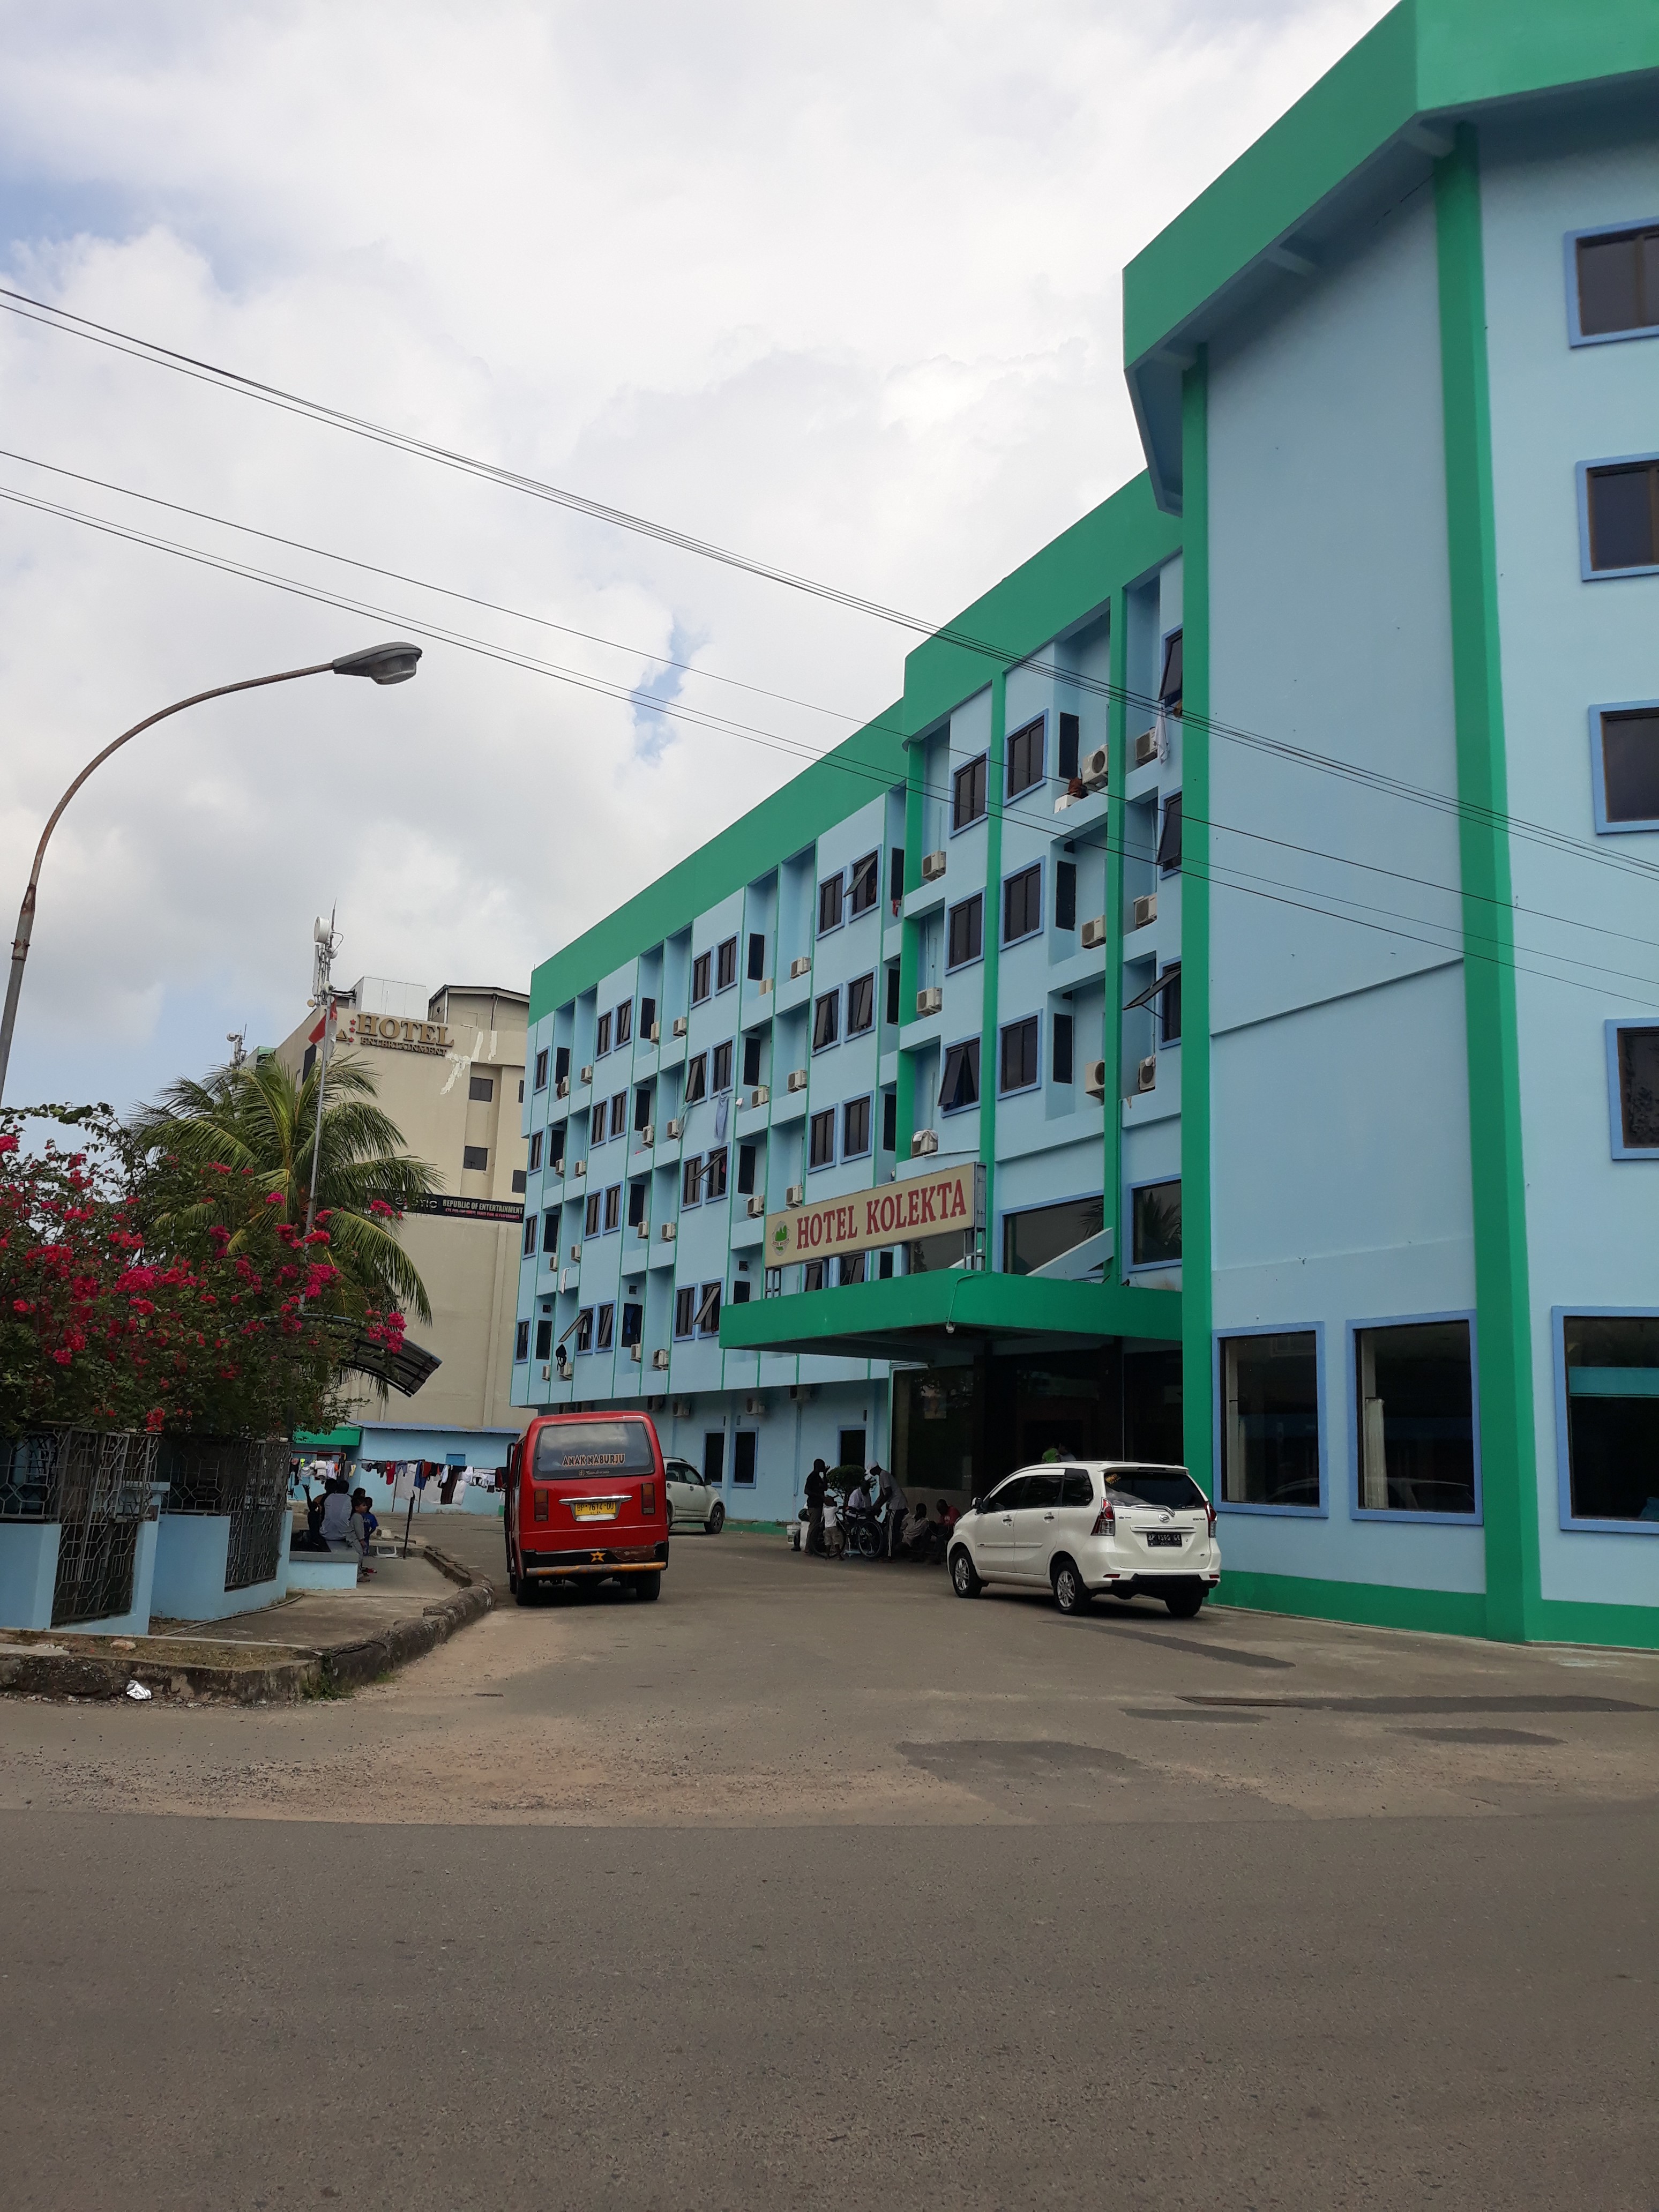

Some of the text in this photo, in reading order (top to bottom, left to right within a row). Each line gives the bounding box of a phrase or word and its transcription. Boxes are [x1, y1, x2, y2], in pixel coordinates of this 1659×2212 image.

[356, 1013, 454, 1047] HOTEL
[361, 1037, 447, 1056] ENTERTAINMENT
[443, 1199, 470, 1209] REPUBLIC
[479, 1203, 523, 1214] ENTERTAINMENT
[796, 1179, 967, 1250] HOTEL KOLEKTA
[562, 1453, 625, 1467] ANAK NABURJU
